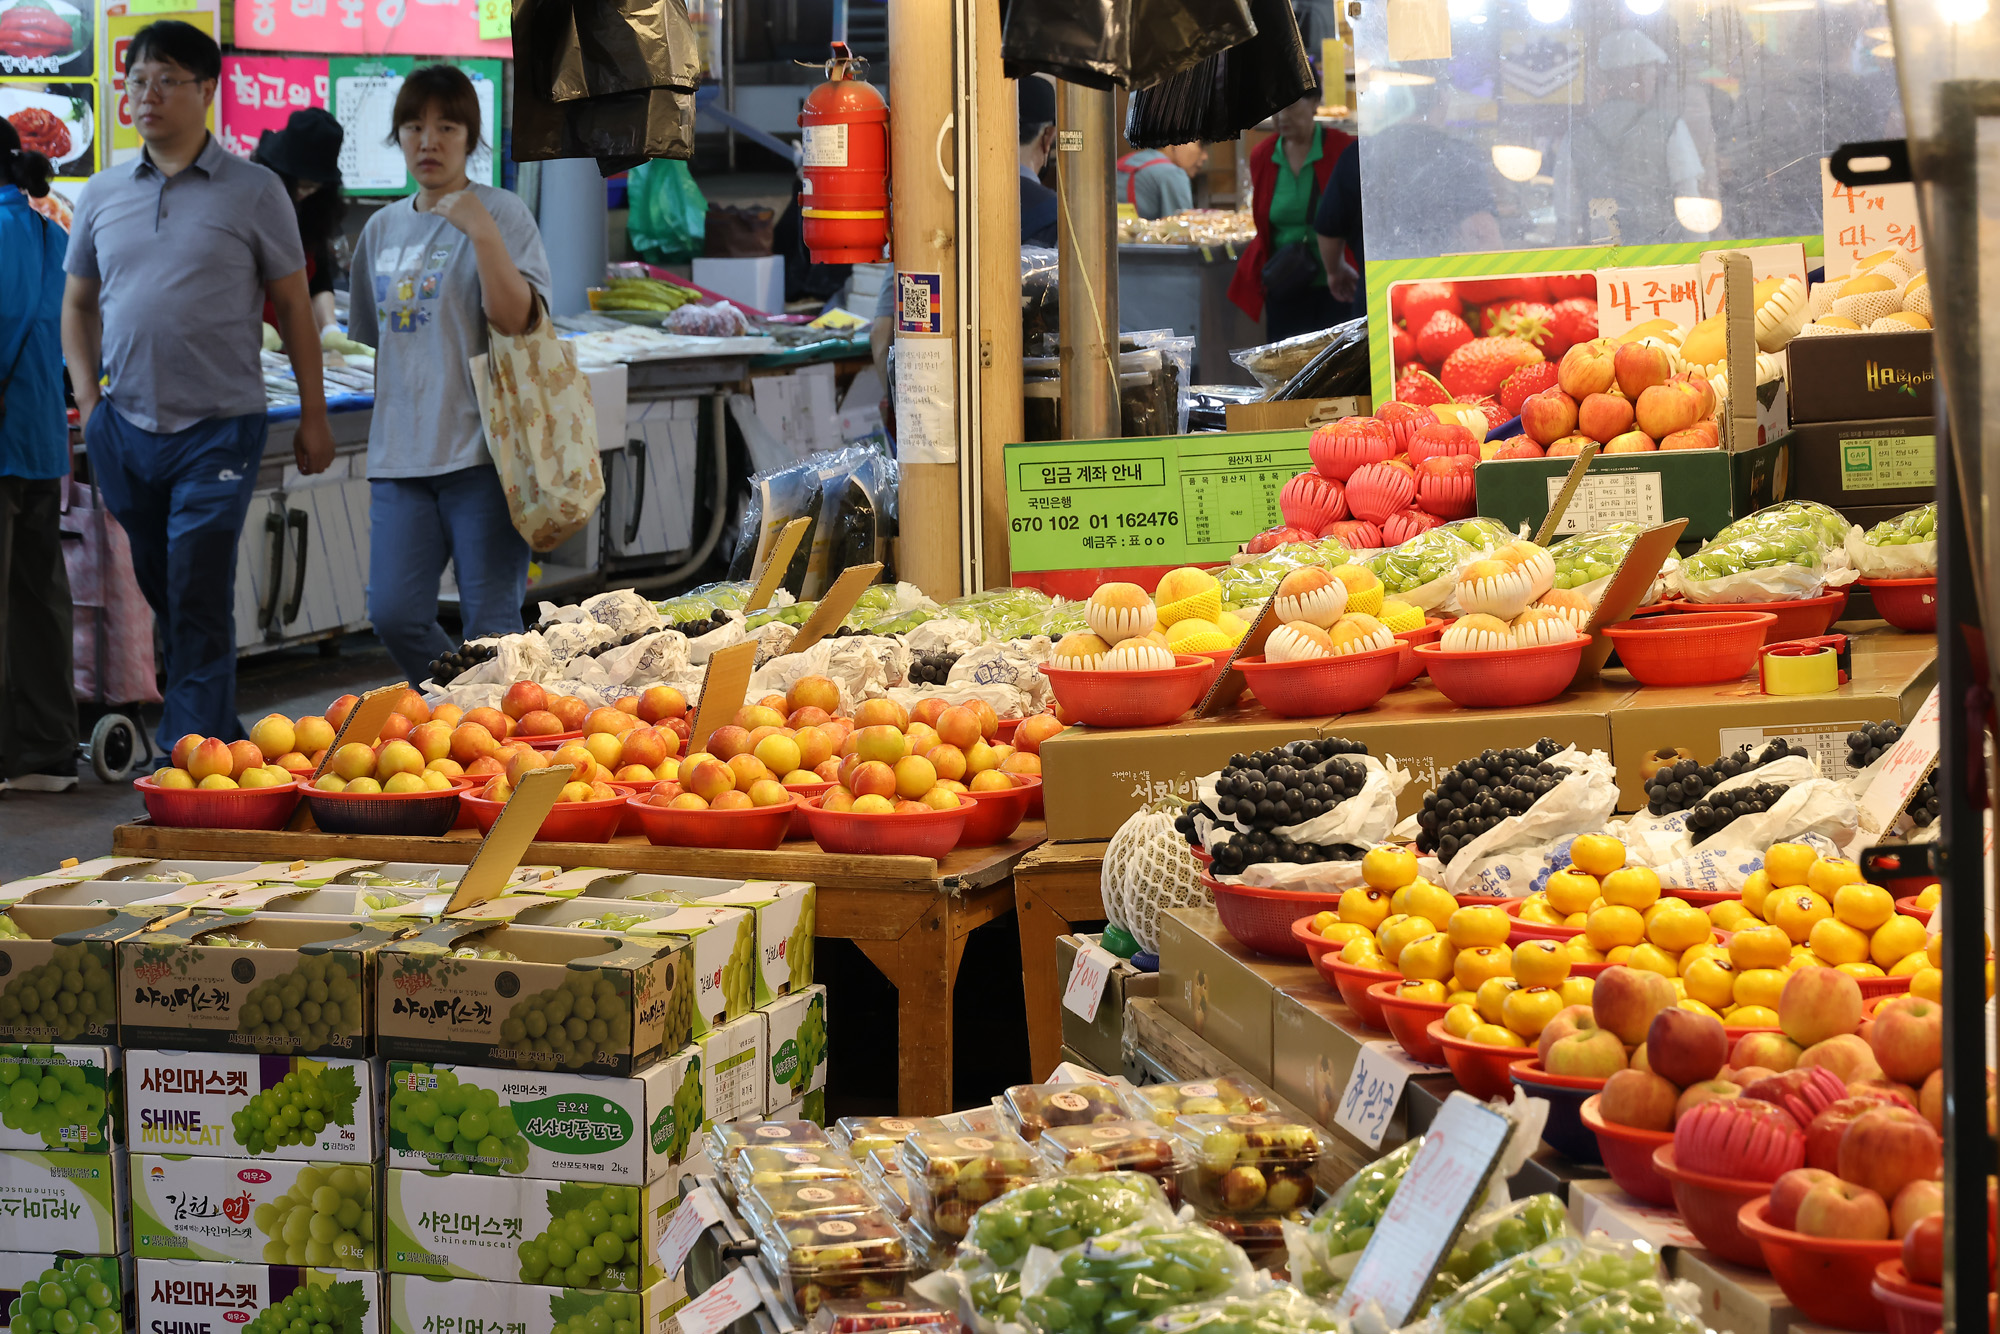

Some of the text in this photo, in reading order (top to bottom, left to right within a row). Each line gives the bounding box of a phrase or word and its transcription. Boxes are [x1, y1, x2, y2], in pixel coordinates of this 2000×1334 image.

[1228, 454, 1272, 465] 원산지 표시
[1042, 463, 1142, 484] 입금 계좌 안내
[1027, 495, 1072, 510] 국민은행
[1012, 511, 1178, 532] 670 102 01 162476
[1567, 520, 1576, 528] 12
[1082, 535, 1117, 549] 예금주
[1422, 756, 1434, 767] 선물
[1112, 771, 1131, 782] 자연이
[1139, 770, 1150, 781] 선물
[135, 984, 231, 1013] 샤인머스켓
[392, 996, 492, 1025] 샤인머스켓
[89, 1023, 109, 1037] 2kg
[332, 1034, 353, 1048] 2kg
[597, 1051, 619, 1066] 2kg
[140, 1067, 249, 1097] 샤인머스켓
[501, 1083, 548, 1096] 샤인머스켓
[556, 1101, 589, 1114] 금오산
[140, 1108, 201, 1132] SHINE
[141, 1122, 225, 1146] MUSCAT
[340, 1129, 356, 1141] 2kg
[551, 1160, 629, 1175] 선산포도작목회 2kg
[242, 1171, 267, 1181] 하우스
[199, 1225, 252, 1239] 샤인머스켓
[418, 1211, 523, 1240] 샤인머스켓
[433, 1235, 513, 1249] Shinemuscat
[606, 1268, 626, 1281] 2kg
[151, 1279, 258, 1309] 샤인머스켓
[227, 1312, 246, 1321] 하우스
